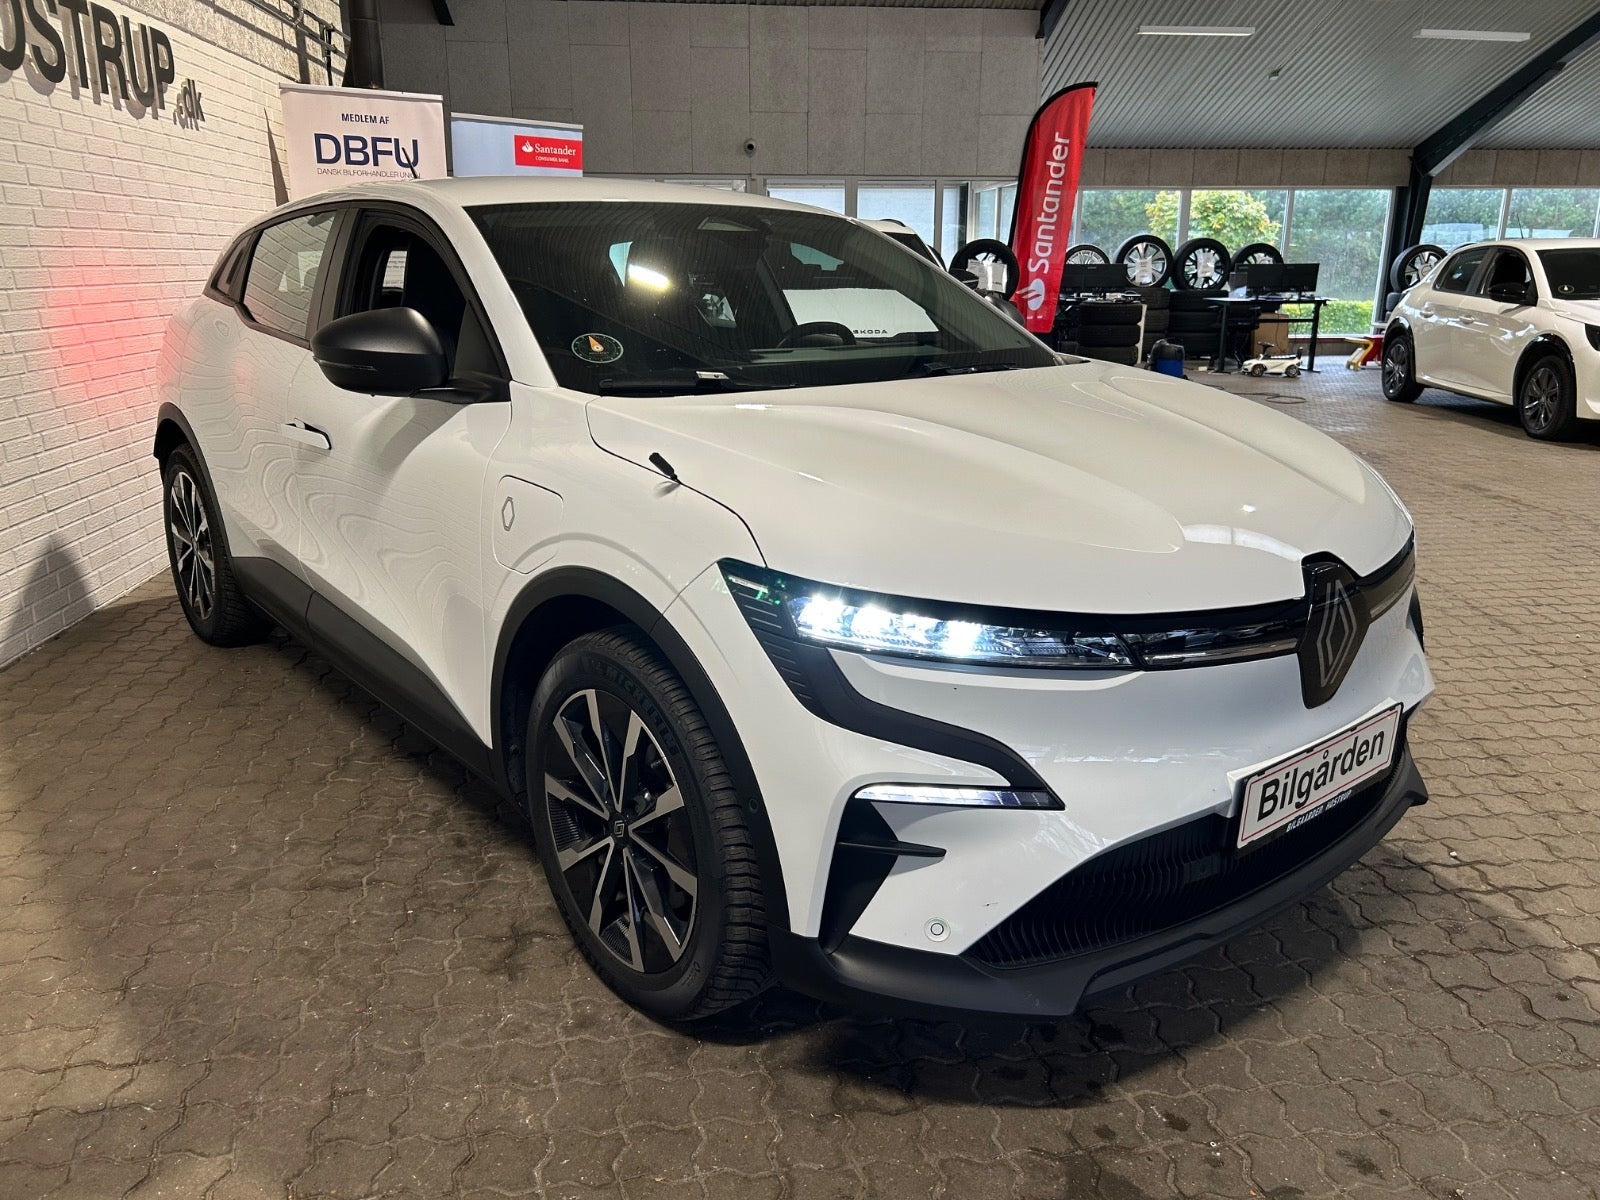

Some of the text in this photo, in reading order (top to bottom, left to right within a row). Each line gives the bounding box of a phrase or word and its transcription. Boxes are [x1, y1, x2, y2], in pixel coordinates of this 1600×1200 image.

[341, 113, 390, 125] MEDLEM AF
[314, 132, 419, 169] DBFU
[535, 143, 577, 156] Santander
[535, 155, 559, 163] CONSUMER
[317, 167, 342, 176] DANSK
[343, 169, 399, 178] BILFORHANDLER
[1028, 131, 1070, 274] Santander
[1257, 730, 1385, 822] Bilgården
